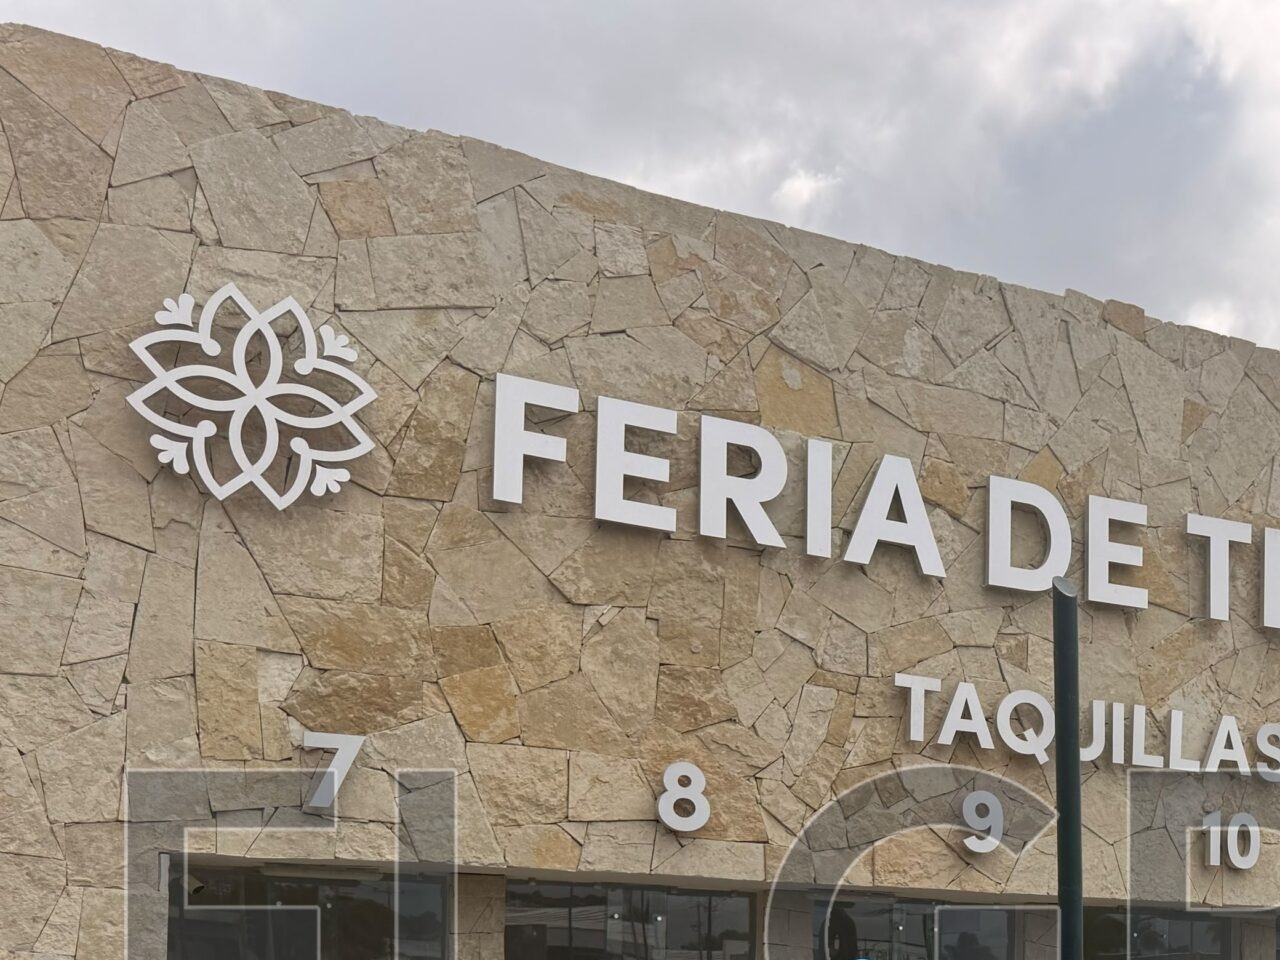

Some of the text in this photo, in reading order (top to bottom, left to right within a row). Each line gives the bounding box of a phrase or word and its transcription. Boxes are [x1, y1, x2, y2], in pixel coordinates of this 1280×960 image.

[493, 373, 946, 578] FERIA
[984, 474, 1149, 610] DE
[303, 731, 366, 808] 7
[657, 761, 711, 833] 8
[961, 790, 1004, 855] 9
[1203, 810, 1261, 871] 10
